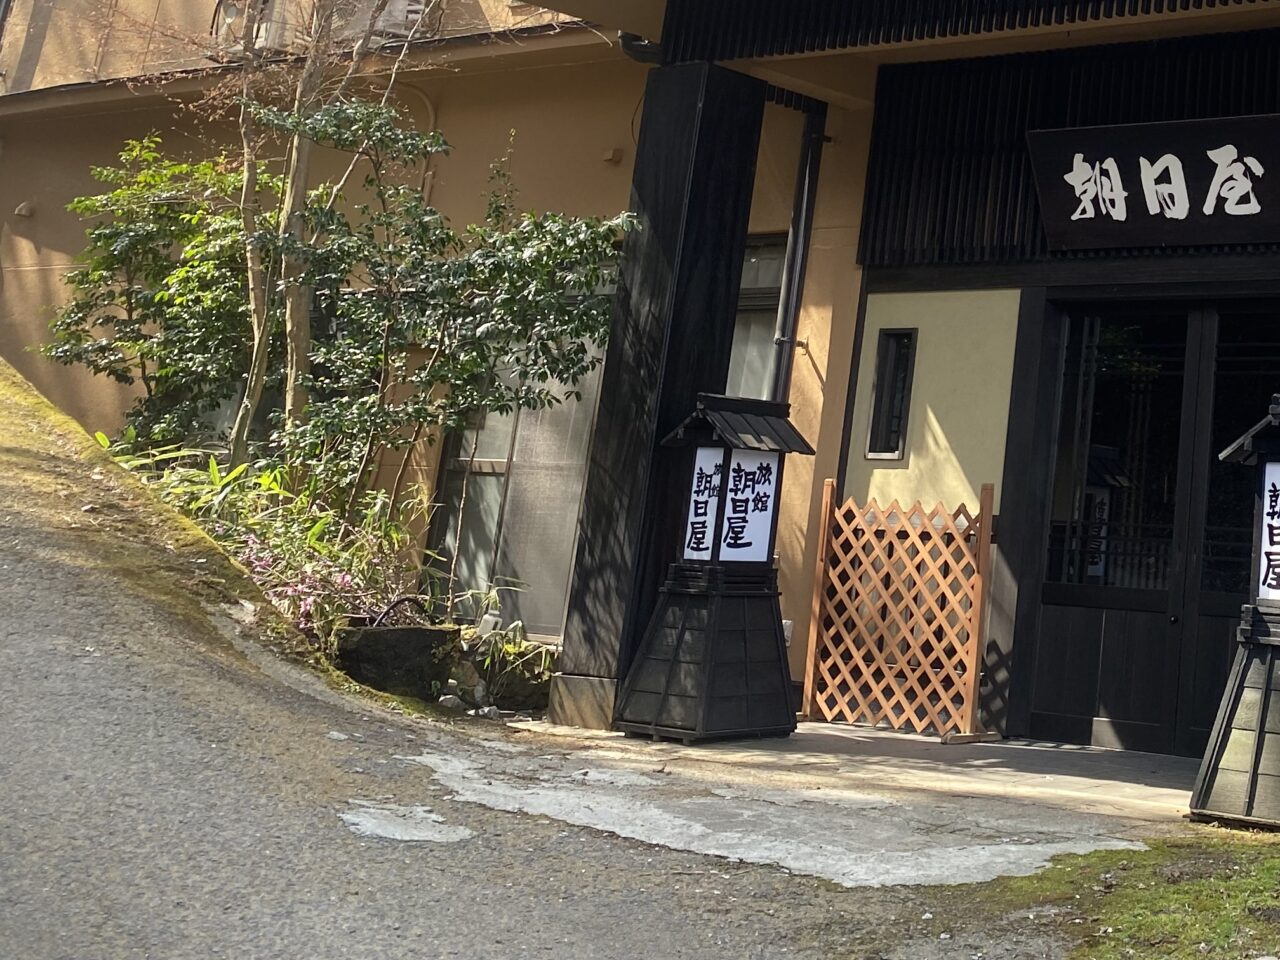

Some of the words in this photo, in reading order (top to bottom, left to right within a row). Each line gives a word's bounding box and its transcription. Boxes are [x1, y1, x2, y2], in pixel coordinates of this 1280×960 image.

[1063, 144, 1264, 221] 朝日屋
[686, 467, 713, 552] 朝日屋
[723, 462, 757, 549] 朝日屋
[751, 462, 773, 513] 旅館
